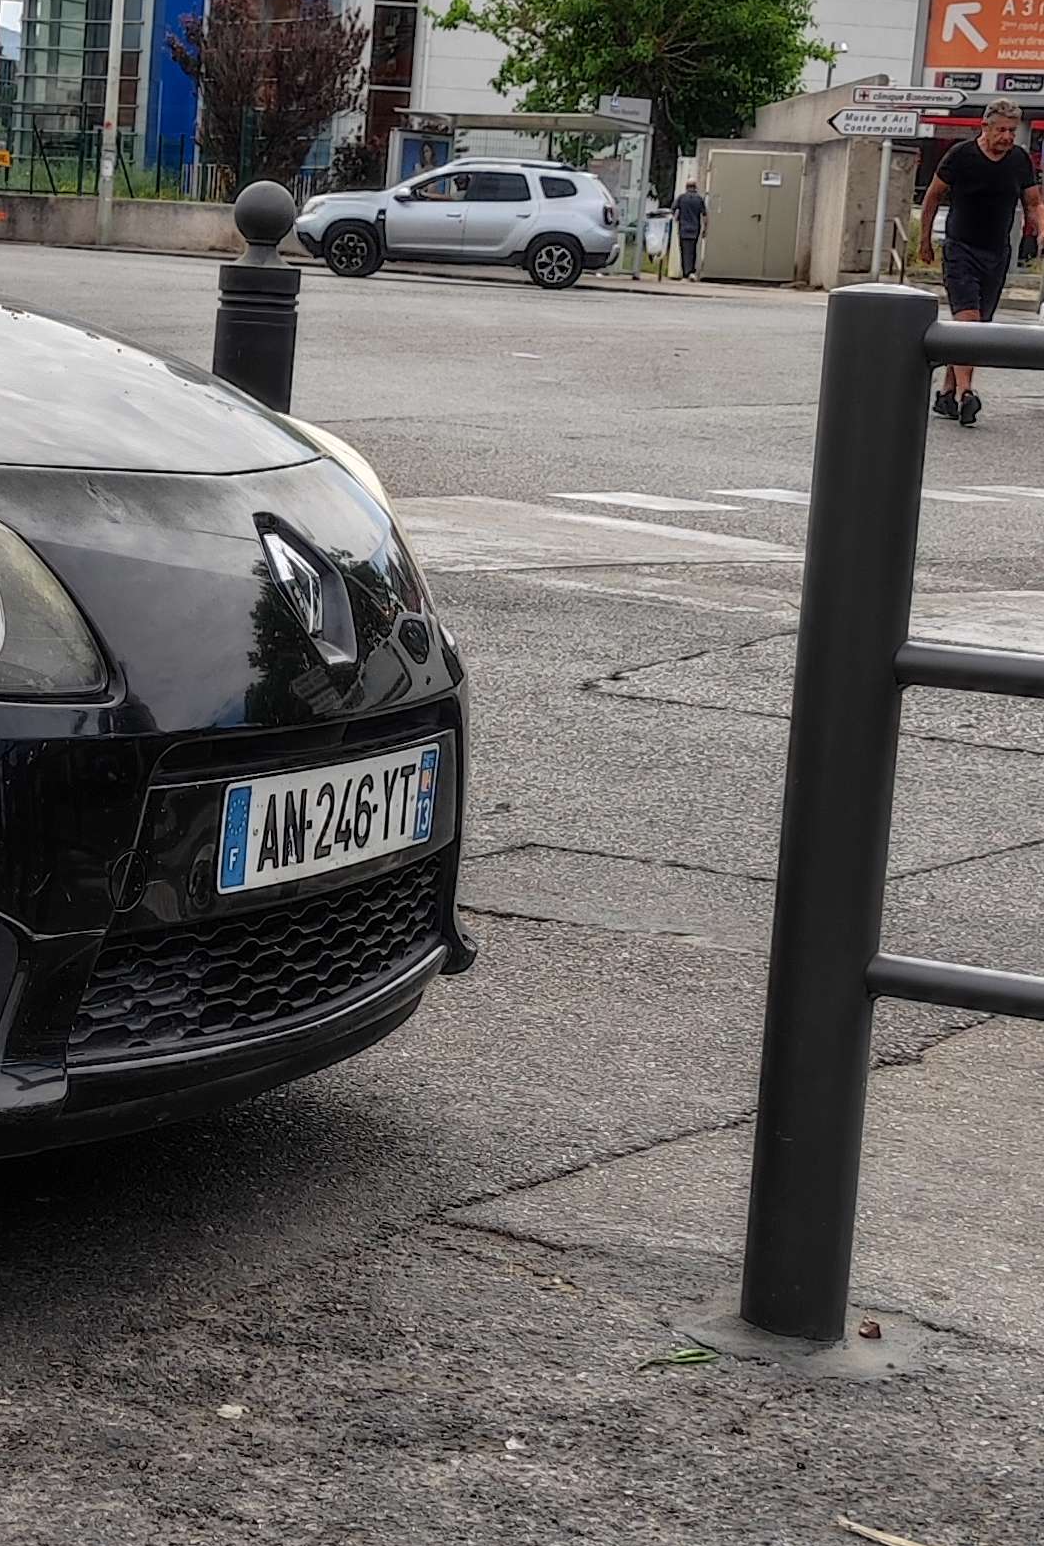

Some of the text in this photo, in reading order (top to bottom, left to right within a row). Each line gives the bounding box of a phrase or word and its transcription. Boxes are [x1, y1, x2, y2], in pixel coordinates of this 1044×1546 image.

[844, 113, 877, 123] Musée
[843, 124, 913, 134] Contemporain
[416, 799, 430, 833] 13
[228, 848, 239, 870] F
